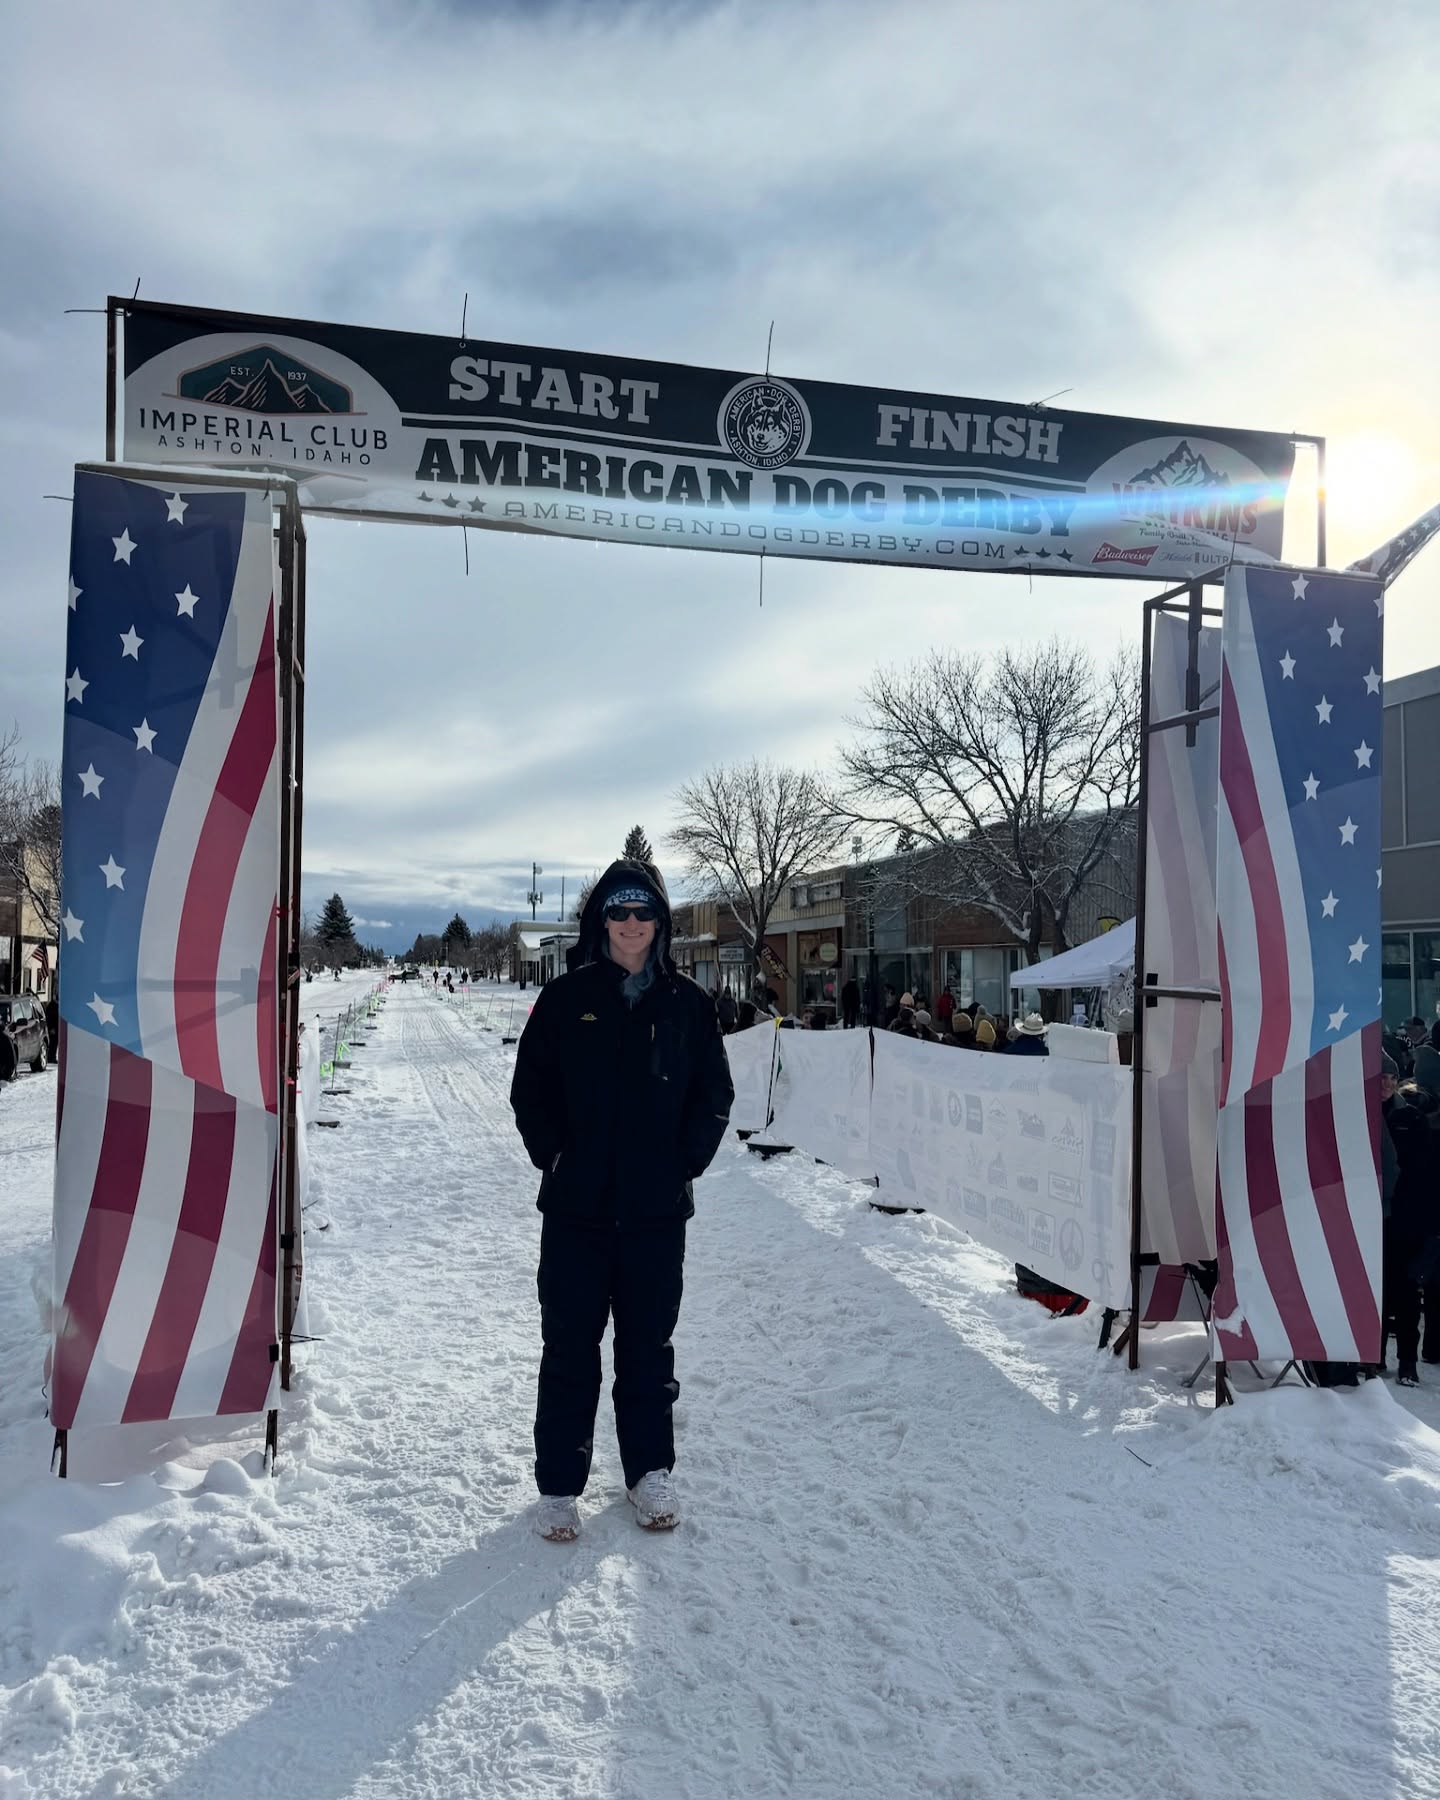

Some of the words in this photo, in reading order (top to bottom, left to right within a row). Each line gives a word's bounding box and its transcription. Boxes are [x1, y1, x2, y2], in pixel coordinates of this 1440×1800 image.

[230, 366, 255, 377] EST.
[287, 371, 307, 382] 1937
[448, 355, 660, 425] START
[730, 387, 765, 421] AMERICAN
[770, 388, 789, 403] DOG
[789, 406, 801, 438] DERBY
[139, 408, 294, 443] IMPERIAL
[311, 425, 389, 450] CLUB
[876, 403, 1064, 464] FINISH
[292, 447, 372, 466] IDAHO
[762, 452, 788, 466] IDAHO
[415, 437, 753, 513] AMERICAN
[772, 474, 888, 522] DOG
[903, 484, 1079, 537] DERBY
[502, 500, 1005, 559] AMERICANDOGDERBY.COM
[1097, 547, 1153, 561] Budweiser
[1202, 553, 1230, 564] ULTR
